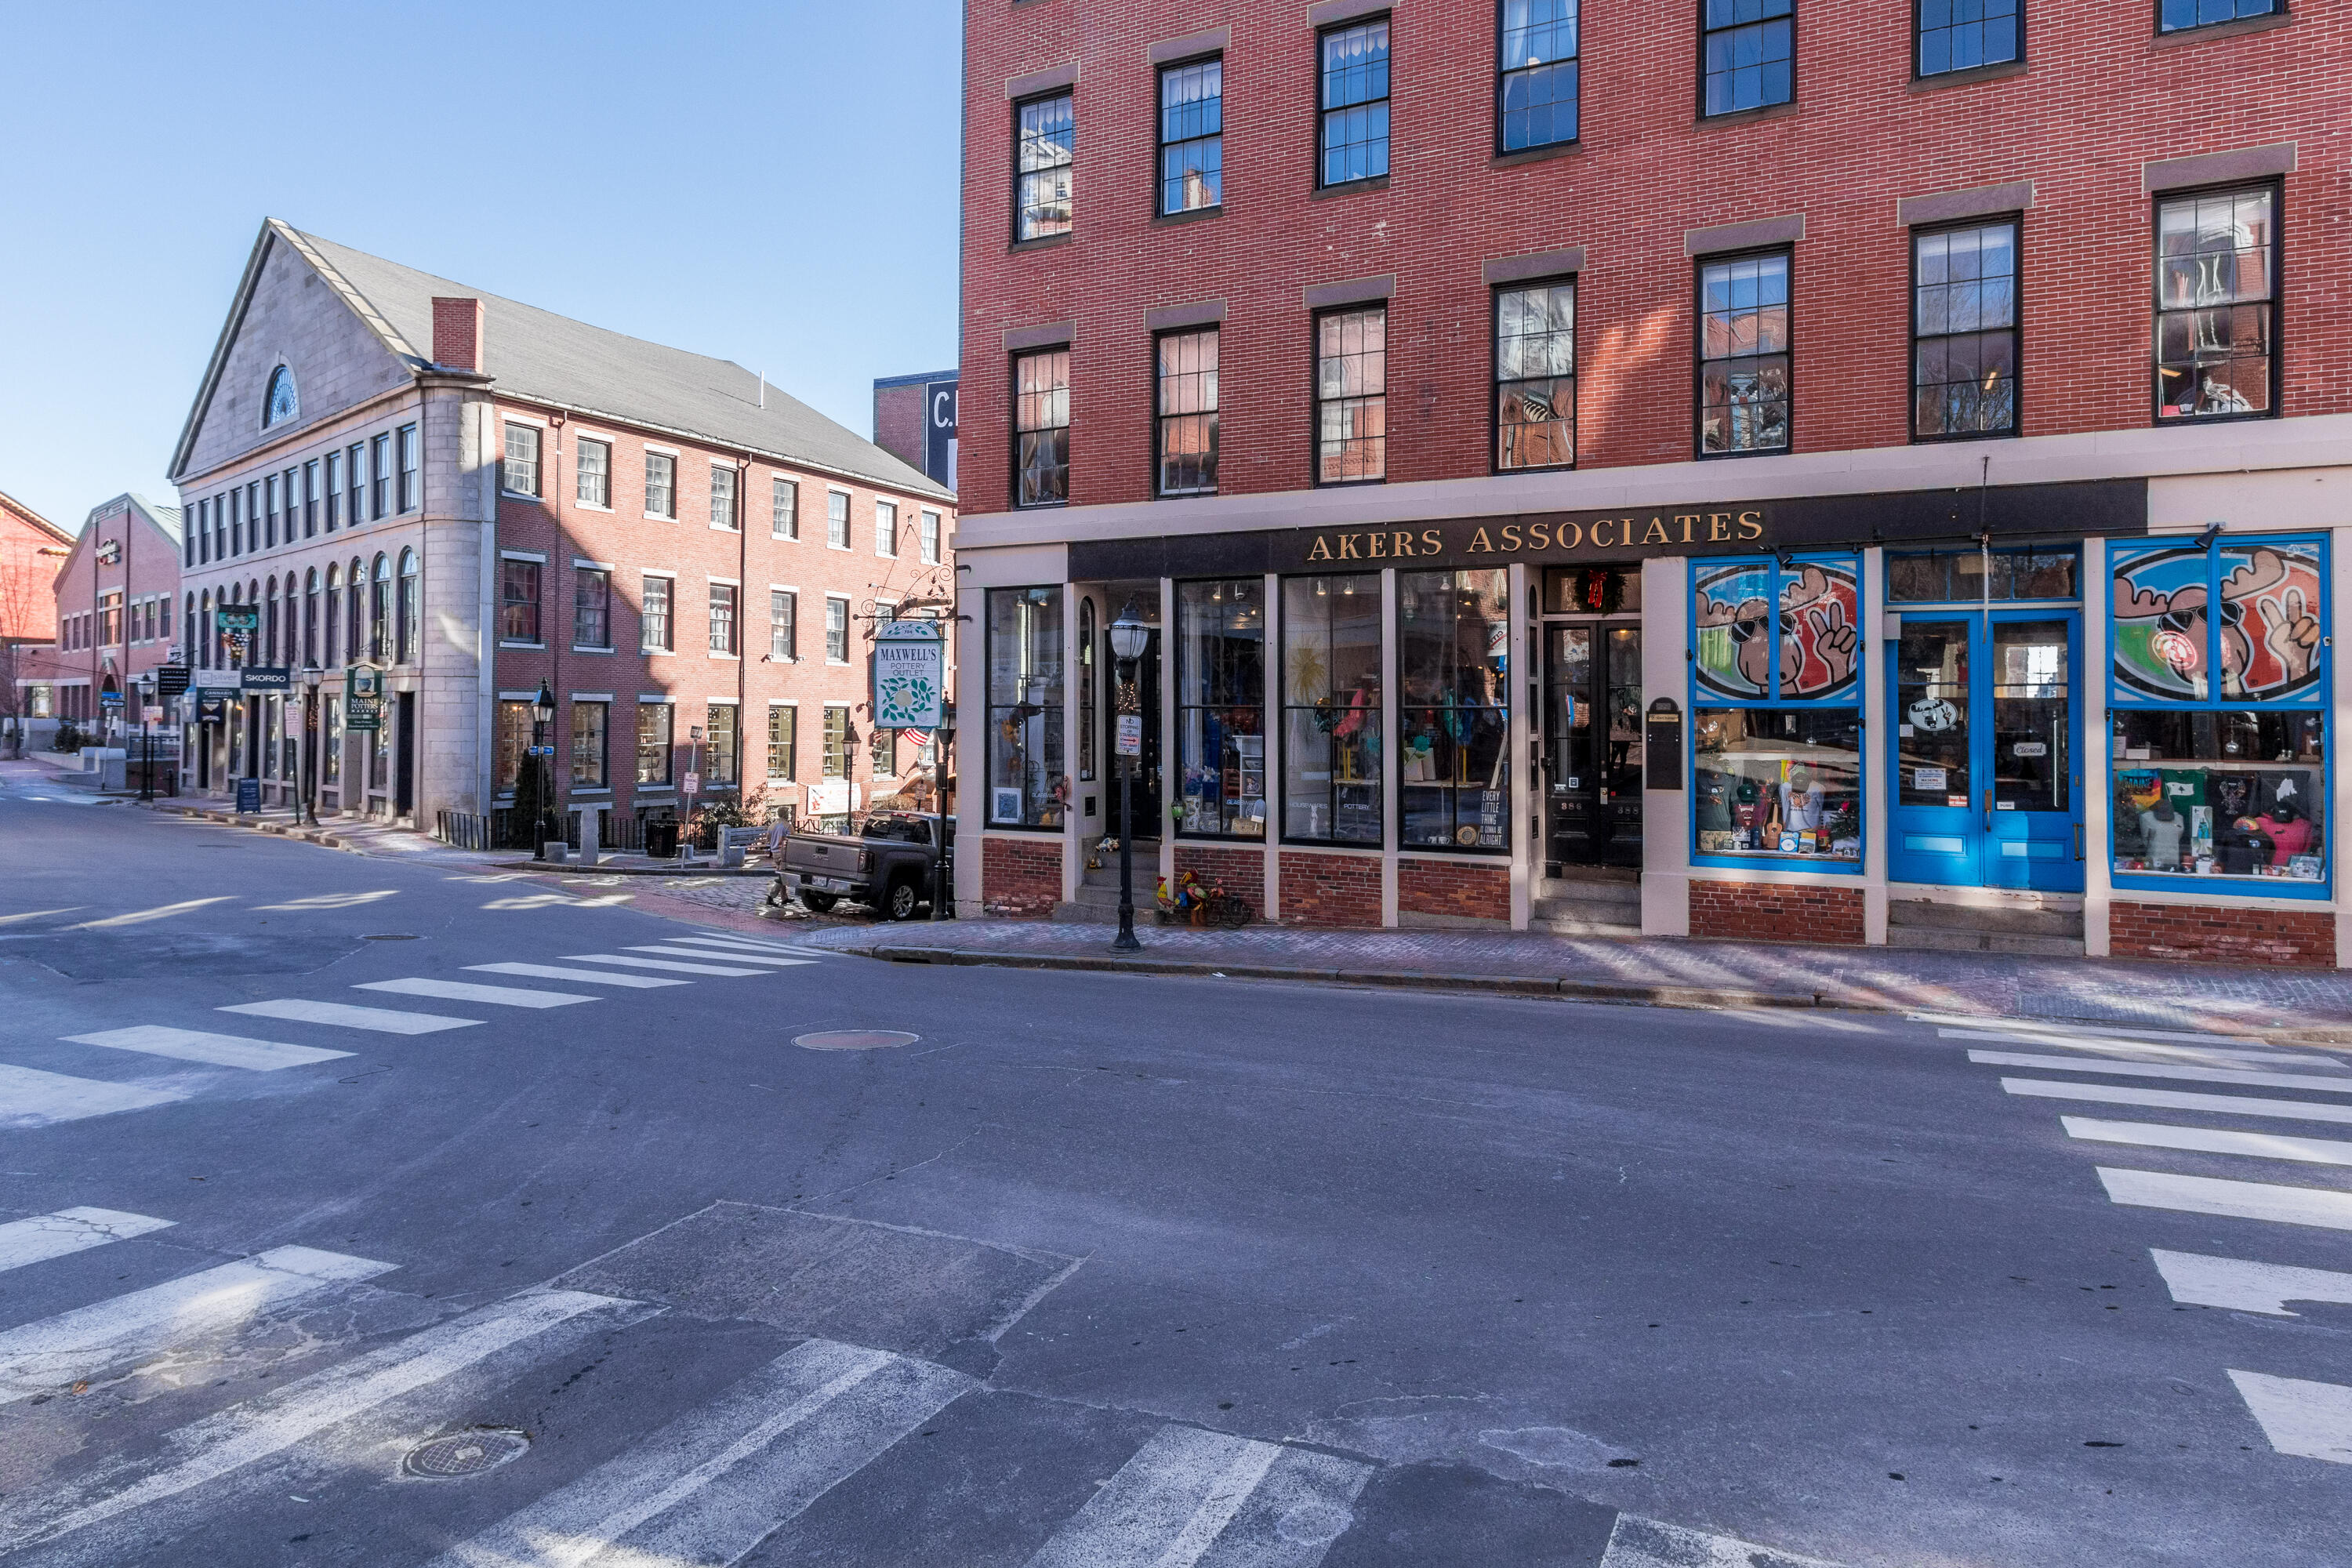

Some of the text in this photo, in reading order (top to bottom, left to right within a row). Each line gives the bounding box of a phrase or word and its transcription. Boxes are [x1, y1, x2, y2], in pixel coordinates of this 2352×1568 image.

[934, 390, 958, 428] C.
[1307, 511, 1763, 561] AKERS ASSOCIATES
[880, 648, 937, 661] MAXWELL'S
[245, 674, 286, 683] SKORDO
[2016, 744, 2043, 753] Closed
[1483, 790, 1501, 801] EVERY
[1481, 802, 1500, 813] LITTLE
[1481, 814, 1497, 825] THING
[1479, 834, 1502, 846] ALRIGHT
